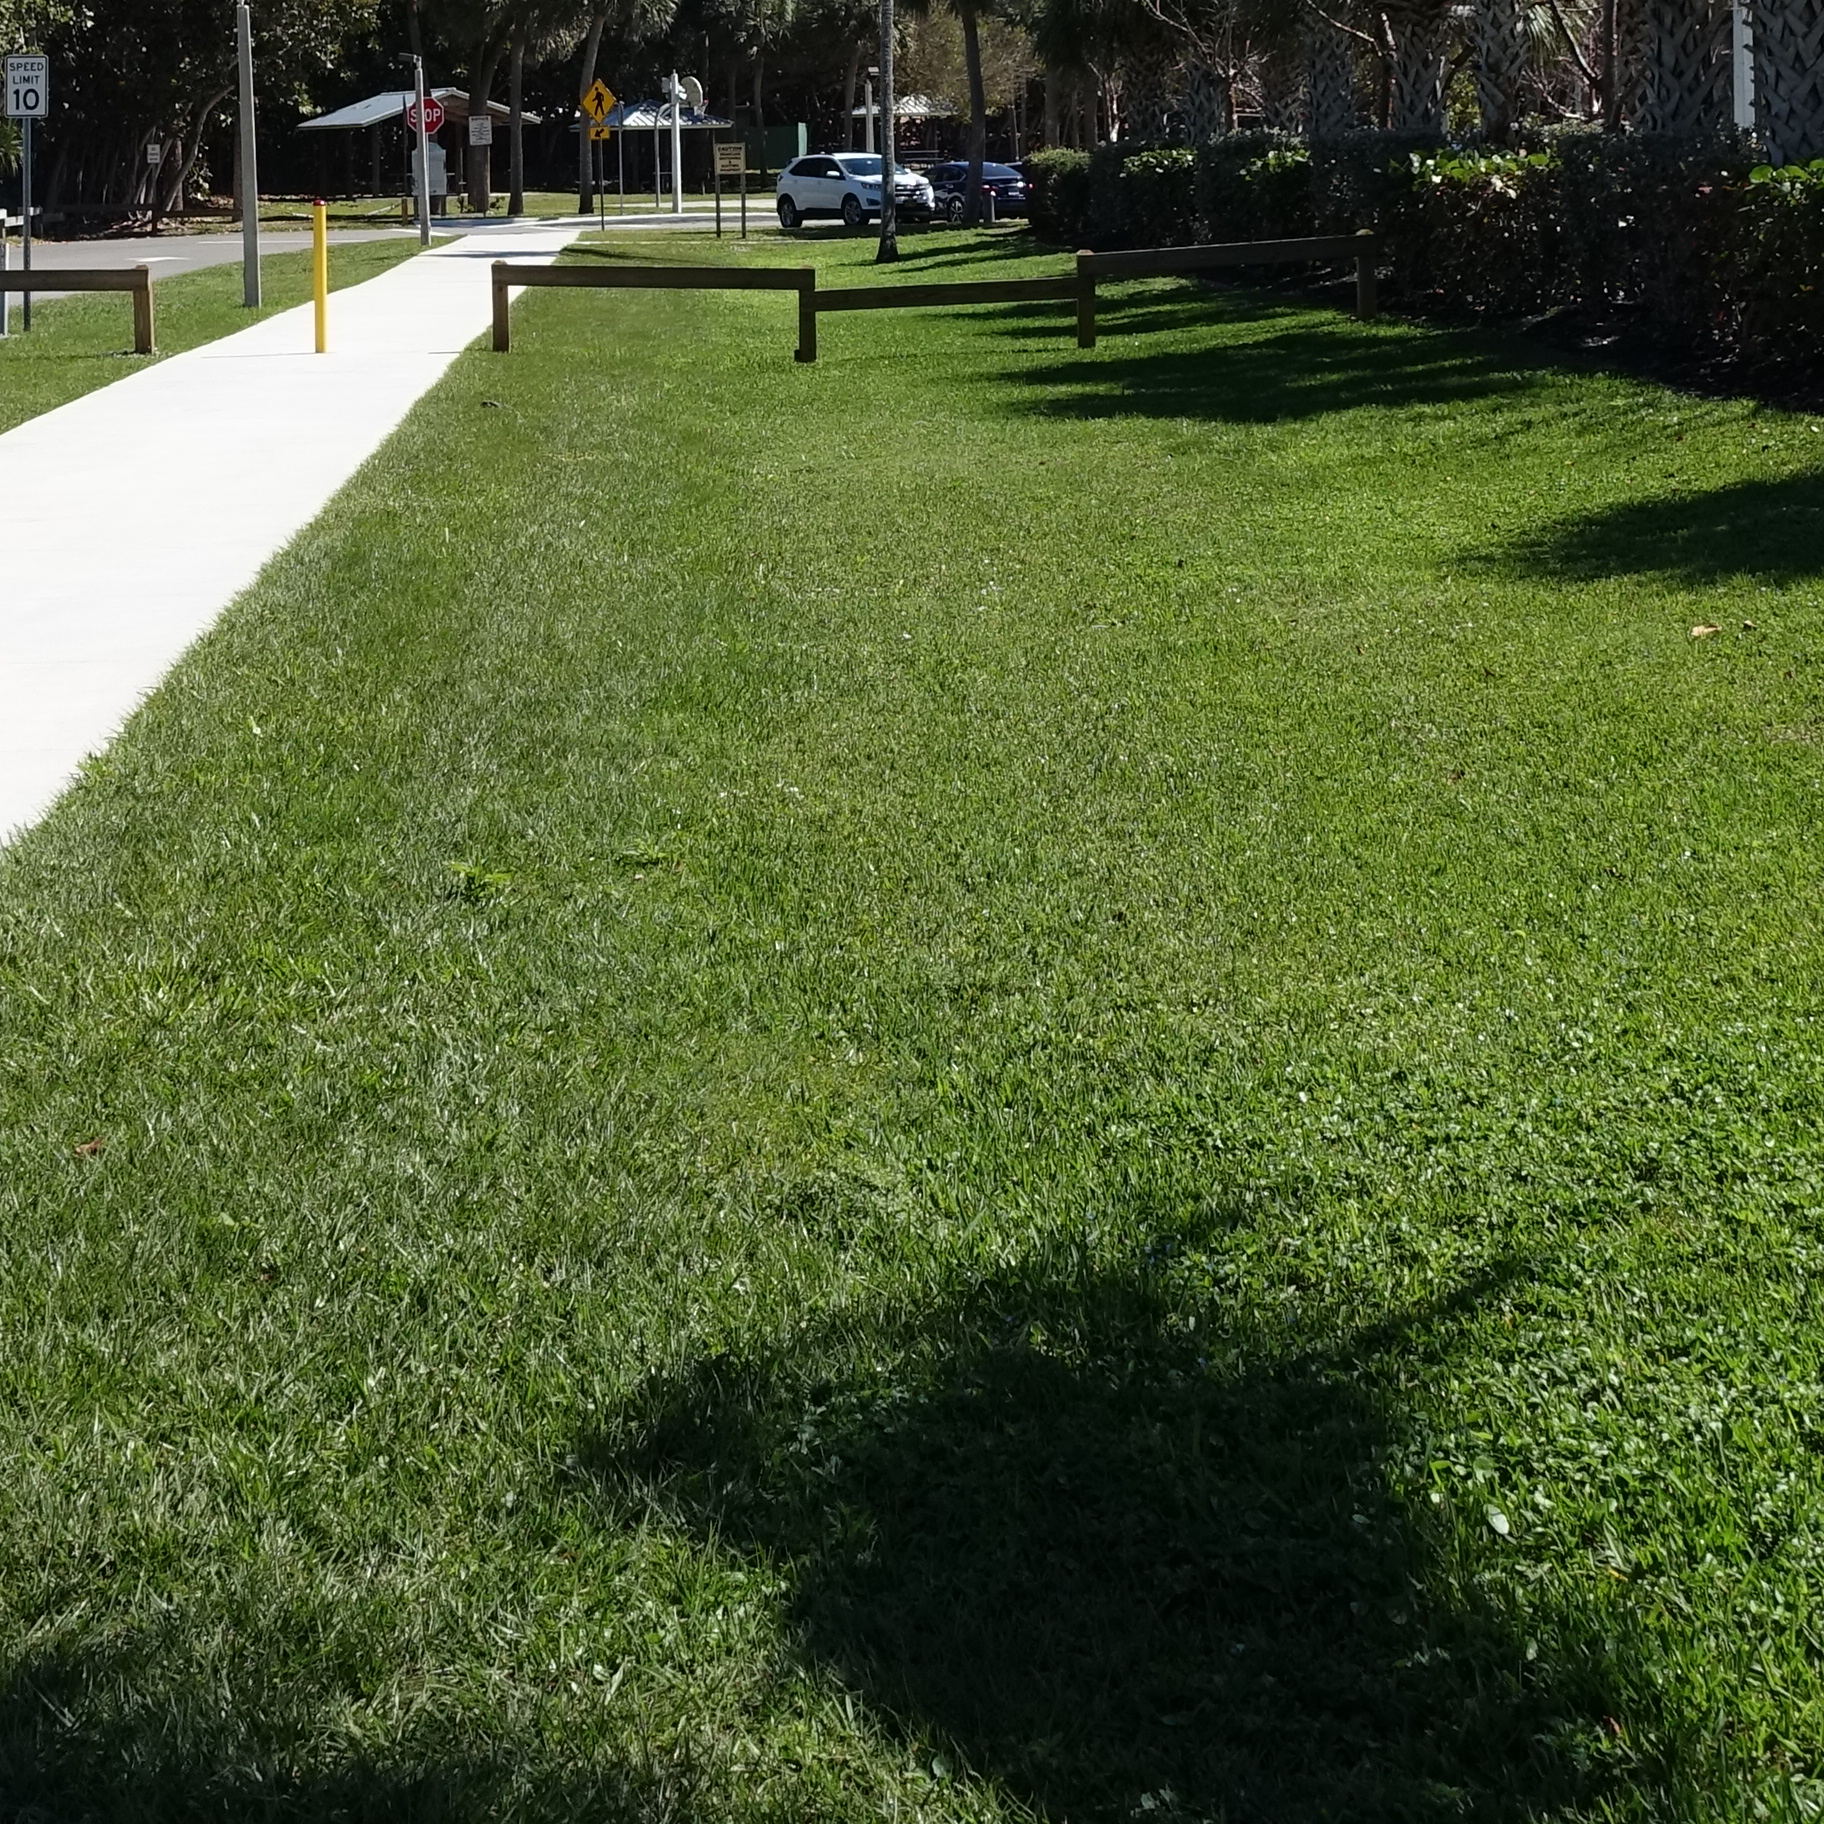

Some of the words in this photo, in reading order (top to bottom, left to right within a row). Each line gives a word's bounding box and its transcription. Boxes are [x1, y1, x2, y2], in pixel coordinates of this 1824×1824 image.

[9, 62, 44, 72] SPEED
[12, 75, 40, 84] LIMIT
[13, 88, 39, 110] 10
[410, 108, 441, 122] SOP
